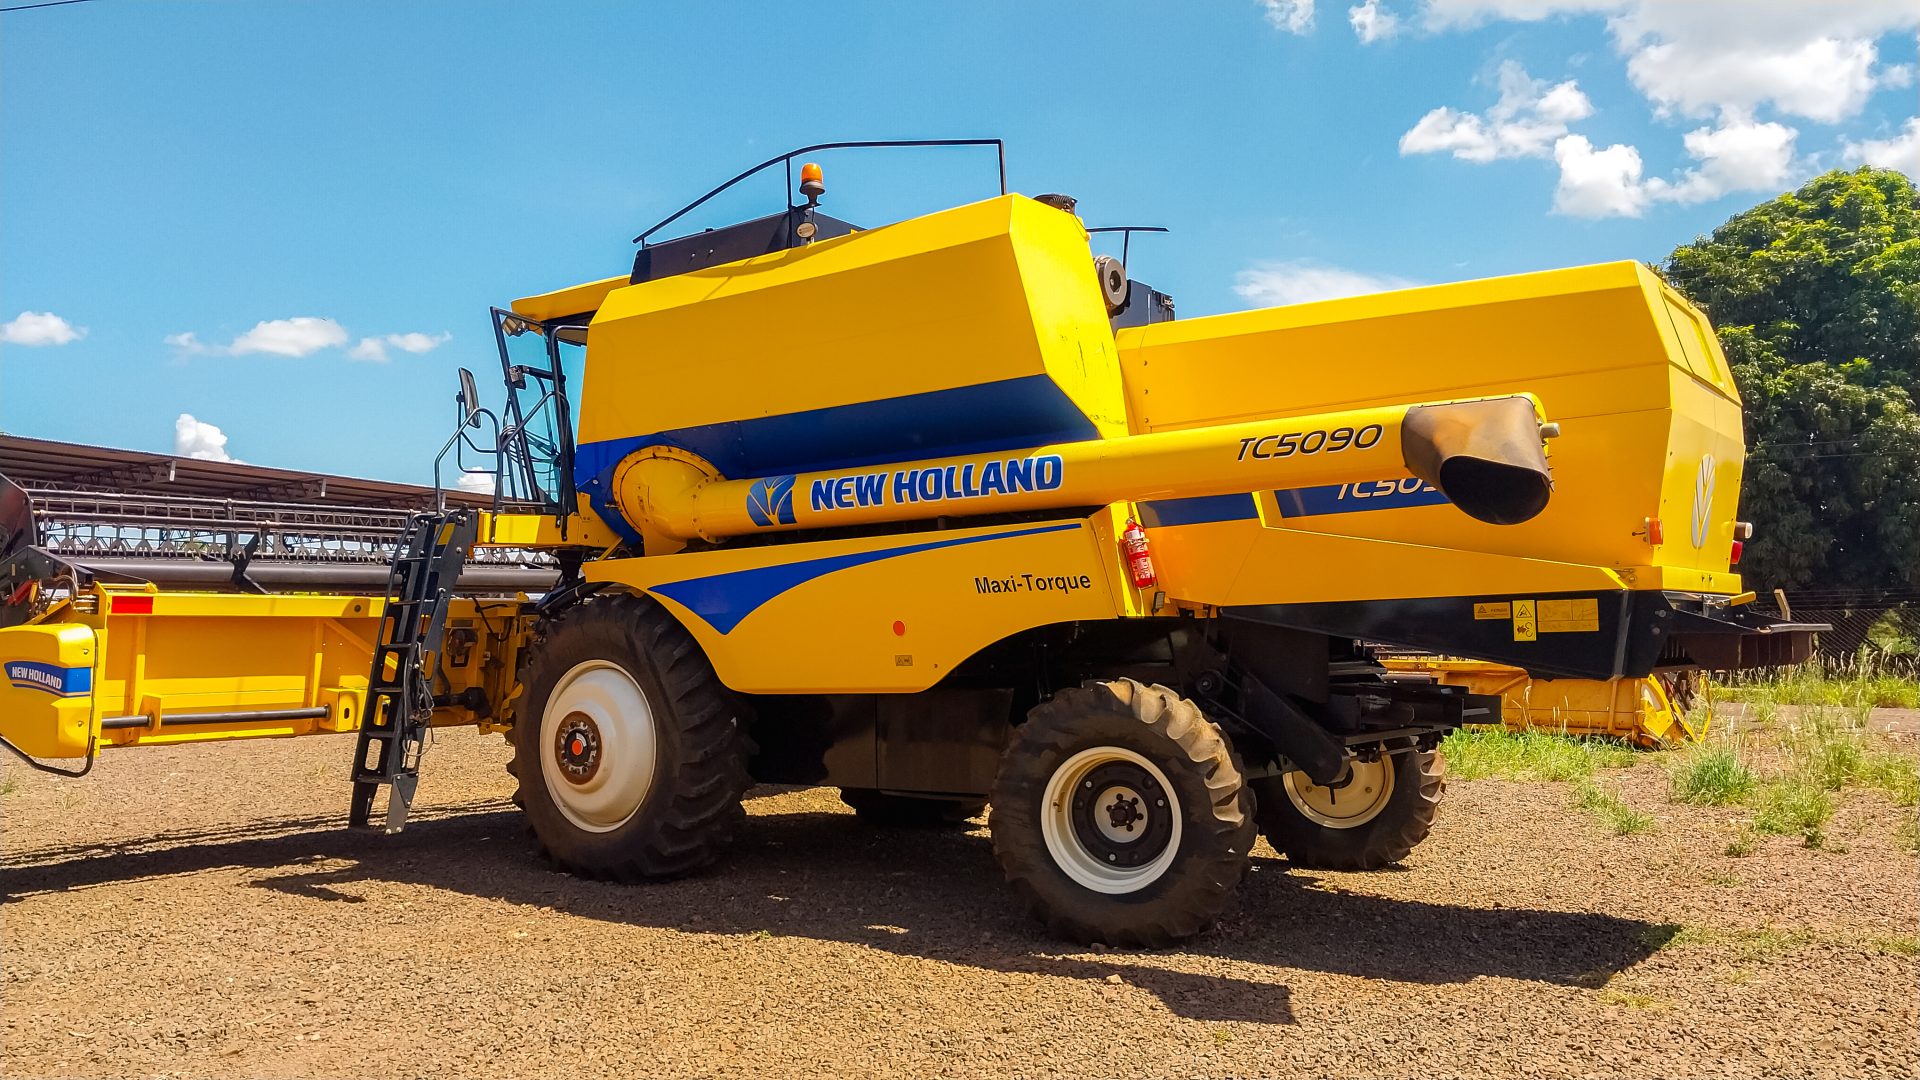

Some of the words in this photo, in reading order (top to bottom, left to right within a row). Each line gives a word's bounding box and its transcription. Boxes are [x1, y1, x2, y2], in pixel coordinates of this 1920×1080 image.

[1237, 424, 1384, 462] TC5090
[811, 473, 888, 512] NEW
[892, 455, 1064, 503] HOLLAND
[974, 573, 1092, 594] Maxi-Torque
[12, 666, 28, 678] NEW
[29, 668, 62, 690] HOLLAND
